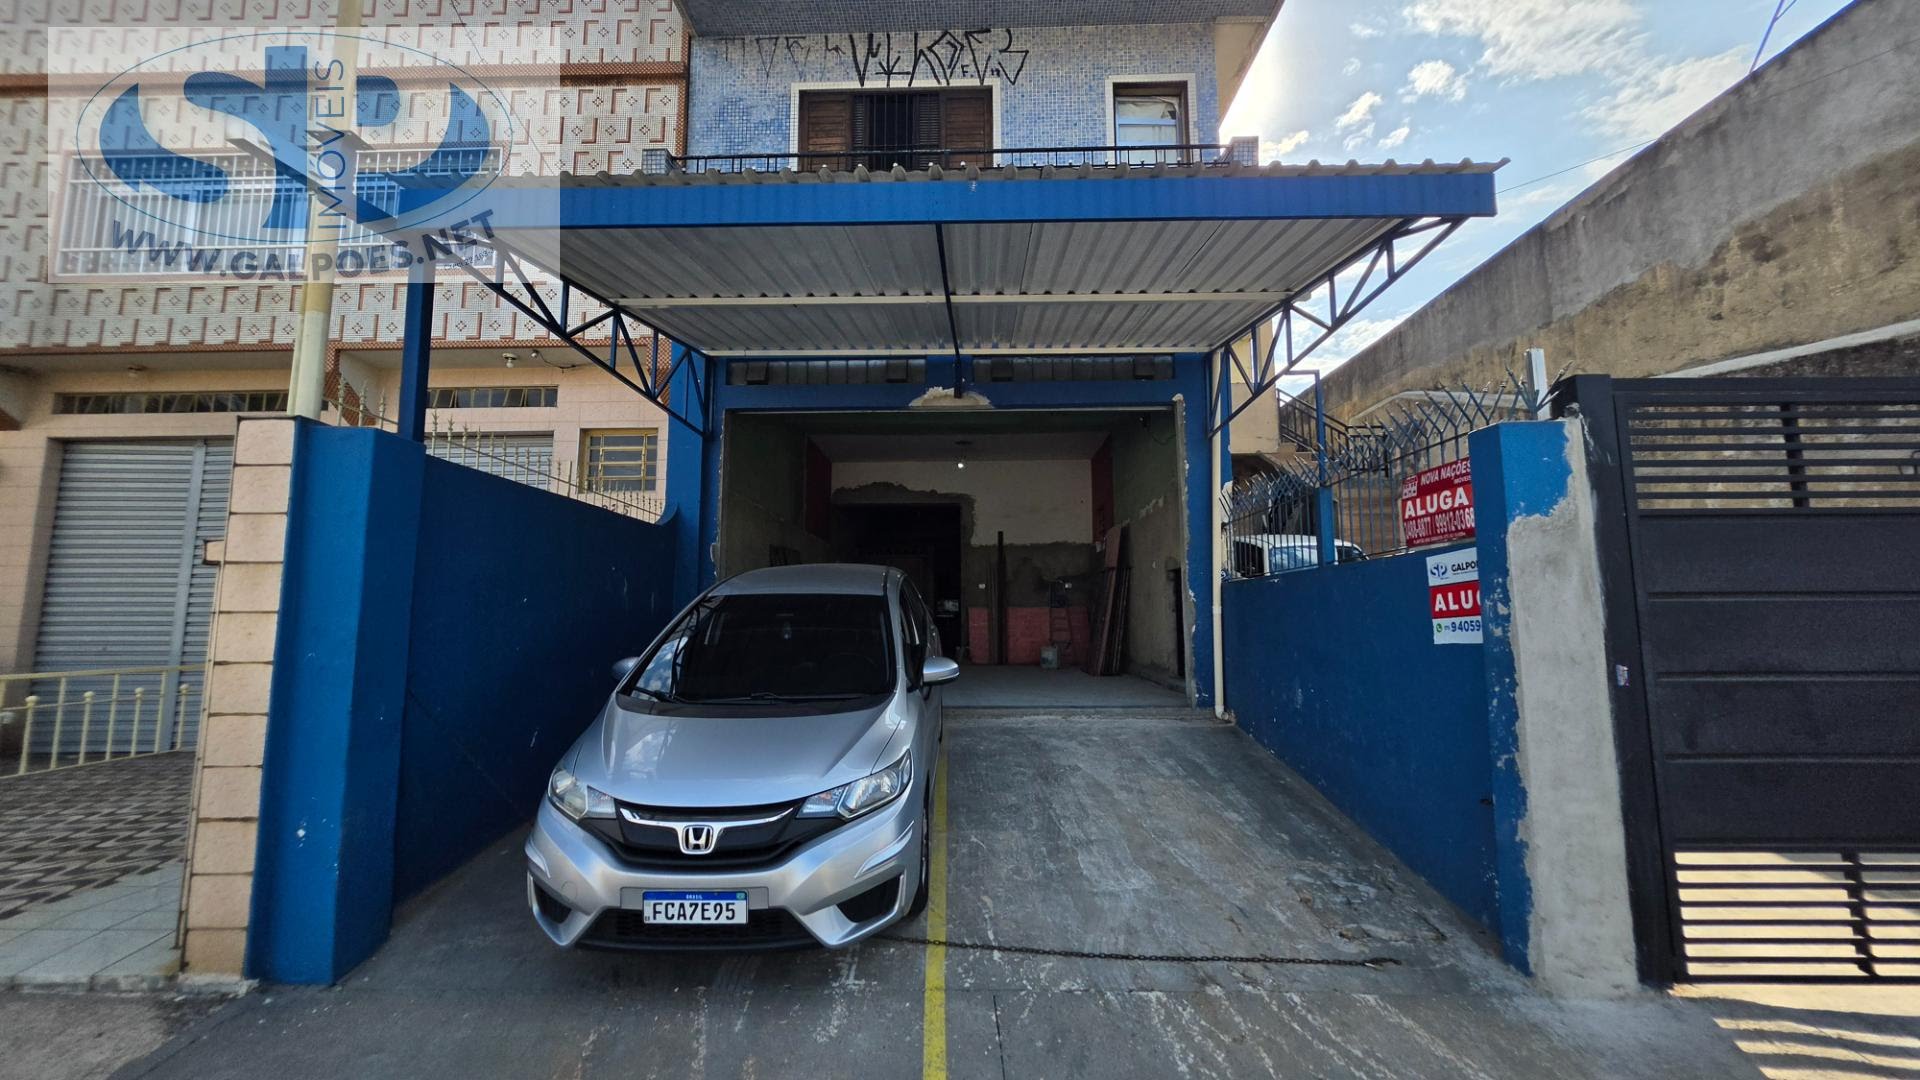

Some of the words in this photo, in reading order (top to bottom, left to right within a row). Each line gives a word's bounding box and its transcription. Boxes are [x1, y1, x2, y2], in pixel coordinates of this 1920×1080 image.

[1420, 469, 1439, 486] NOVA
[1404, 487, 1469, 519] ALUGA
[1451, 560, 1479, 572] GALPO
[652, 902, 735, 921] FCA7E95
